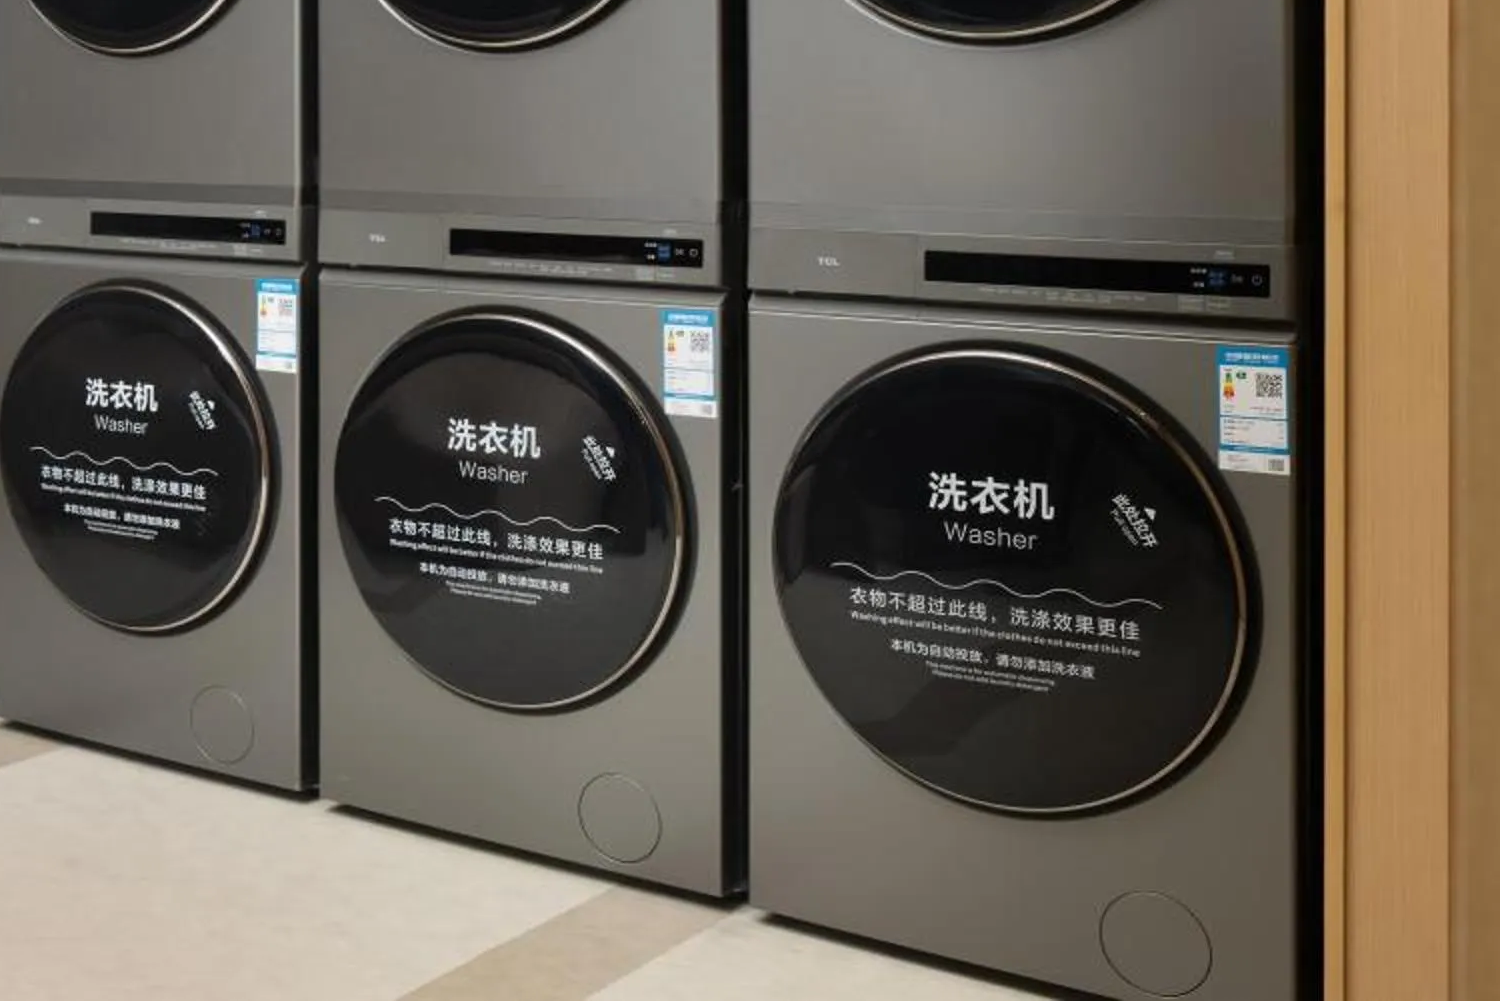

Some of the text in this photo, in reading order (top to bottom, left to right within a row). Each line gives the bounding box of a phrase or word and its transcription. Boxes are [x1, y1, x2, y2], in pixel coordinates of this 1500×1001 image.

[85, 377, 159, 412] 洗衣机
[93, 413, 149, 435] Washer
[447, 417, 542, 459] 洗衣机
[458, 460, 529, 484] Washer
[928, 471, 1055, 520] 洗衣机
[388, 518, 604, 560] 衣物不超过此线，洗涤效果更佳
[943, 520, 1039, 550] Washer
[850, 586, 1141, 641] 衣物不超过此线，洗涤效果更佳
